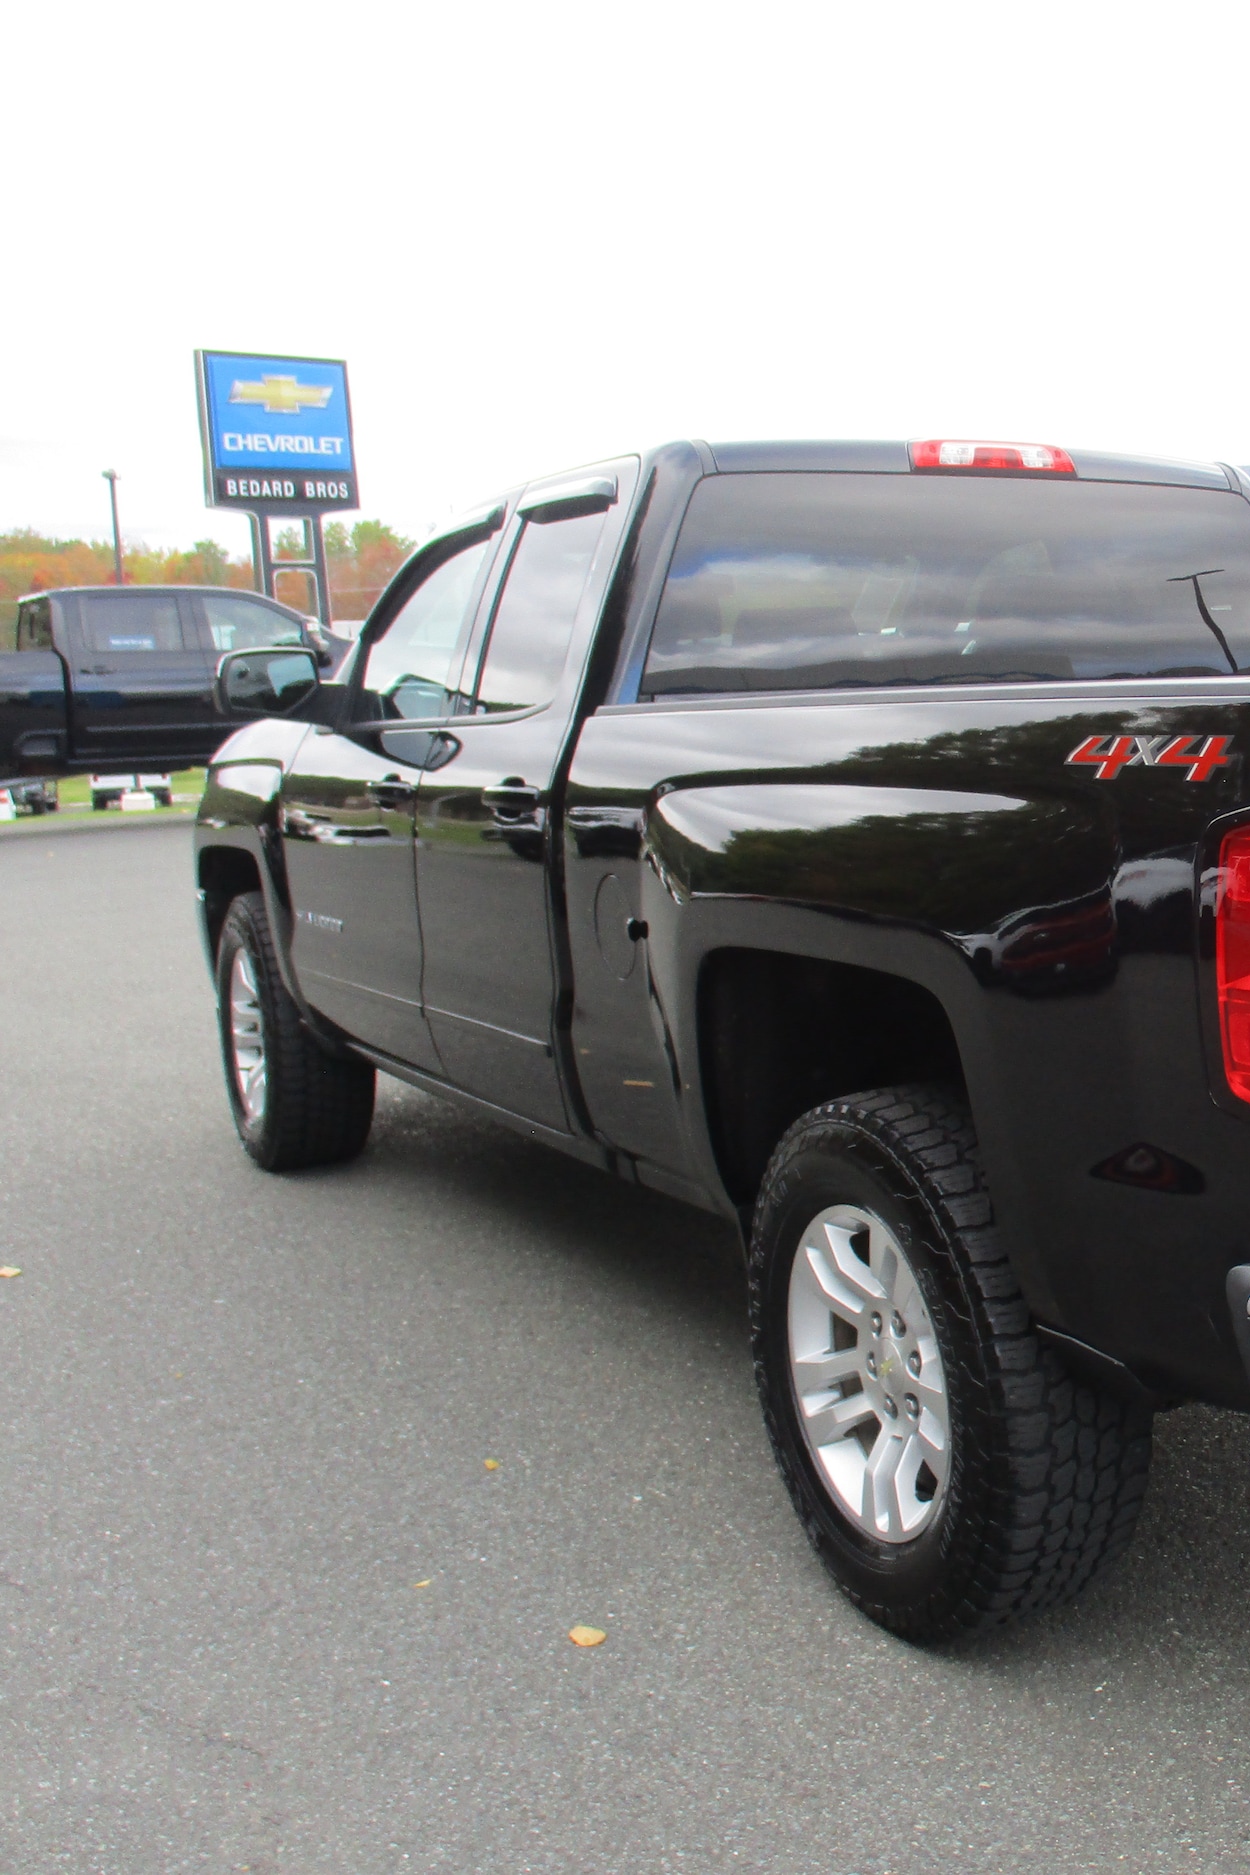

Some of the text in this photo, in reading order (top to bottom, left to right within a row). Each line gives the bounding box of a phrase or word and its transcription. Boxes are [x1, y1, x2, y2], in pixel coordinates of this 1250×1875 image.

[223, 432, 344, 454] CHEVROLET
[227, 479, 349, 499] BEDARD BROS
